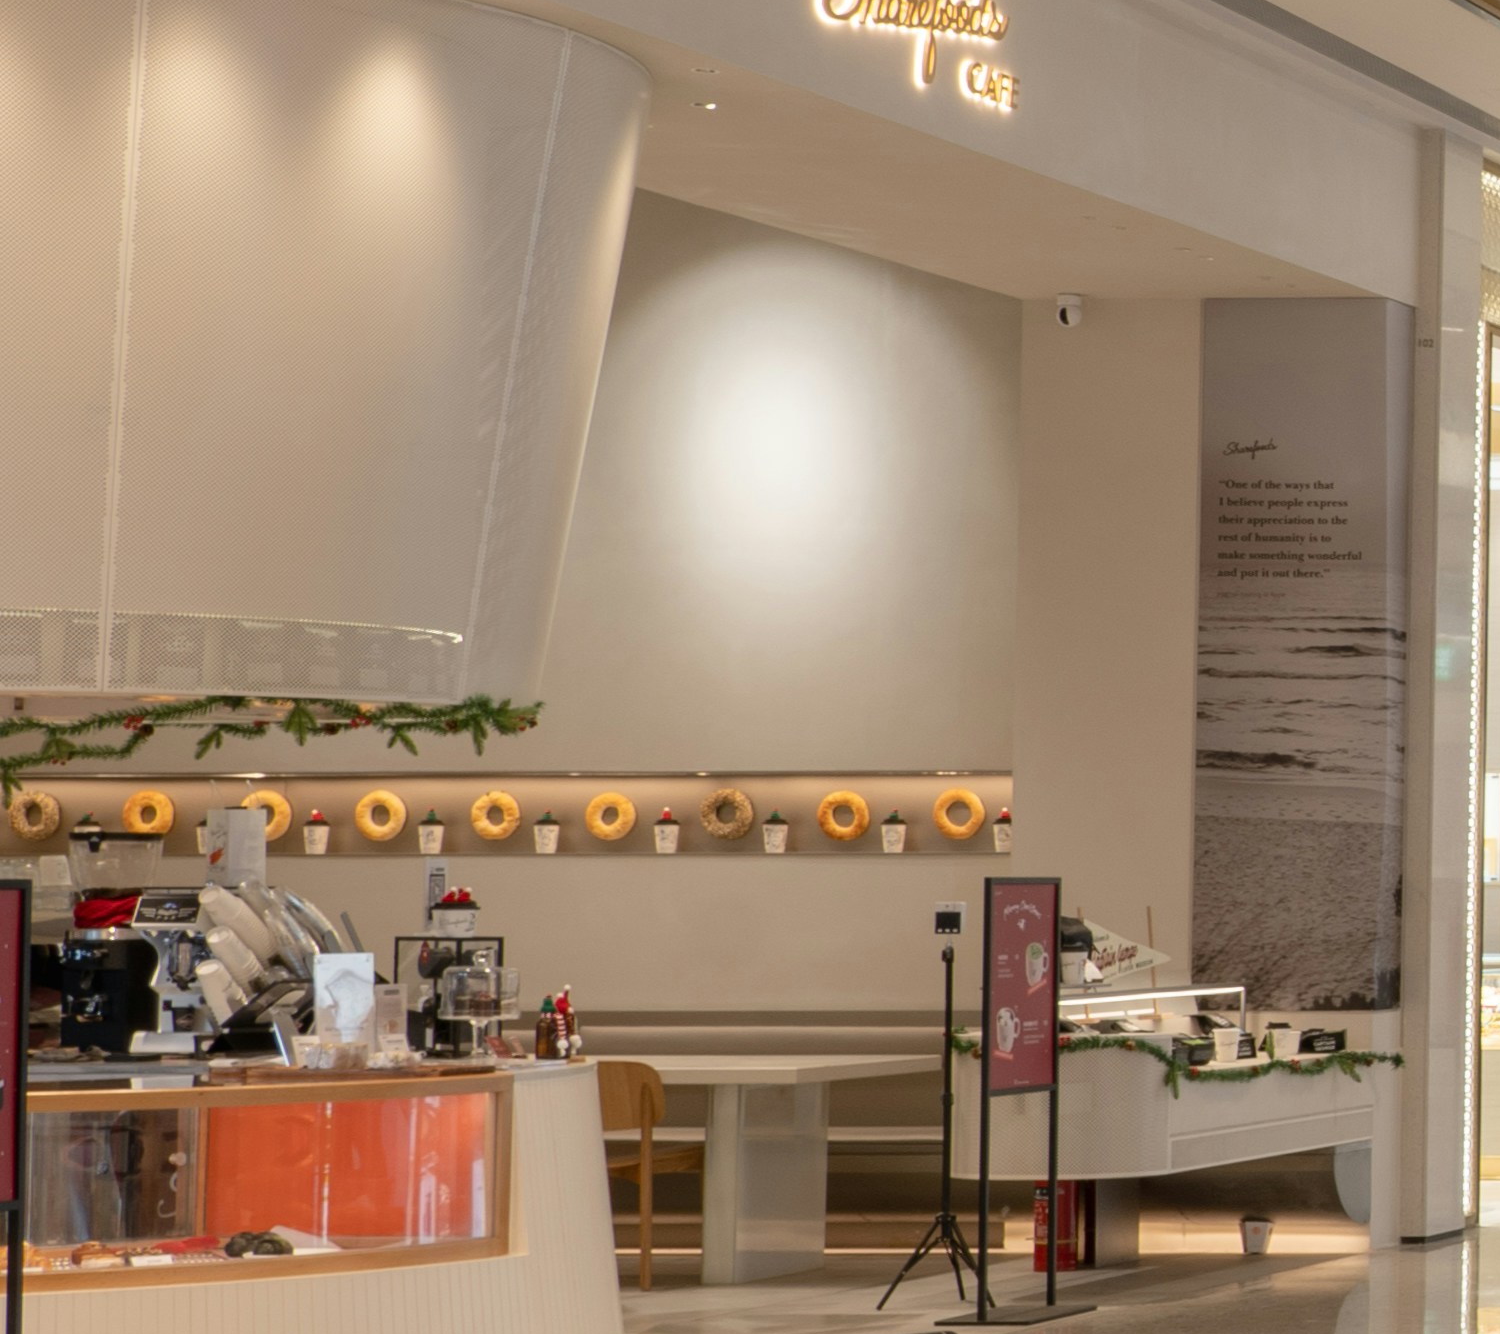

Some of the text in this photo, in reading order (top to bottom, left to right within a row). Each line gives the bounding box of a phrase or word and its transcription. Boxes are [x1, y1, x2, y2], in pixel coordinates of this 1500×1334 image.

[964, 62, 1021, 110] CAFE
[1251, 480, 1263, 490] of
[1265, 480, 1282, 490] the
[1285, 482, 1310, 492] ways
[1314, 480, 1334, 490] that
[1218, 497, 1348, 510] I believe people express
[1218, 515, 1348, 527] their appreciation to the
[1218, 533, 1332, 546] rest of humanity is to
[1217, 550, 1363, 563] make something wonderful
[1217, 569, 1237, 577] and
[1240, 569, 1260, 580] put
[1261, 569, 1269, 577] it
[1272, 569, 1289, 578] out
